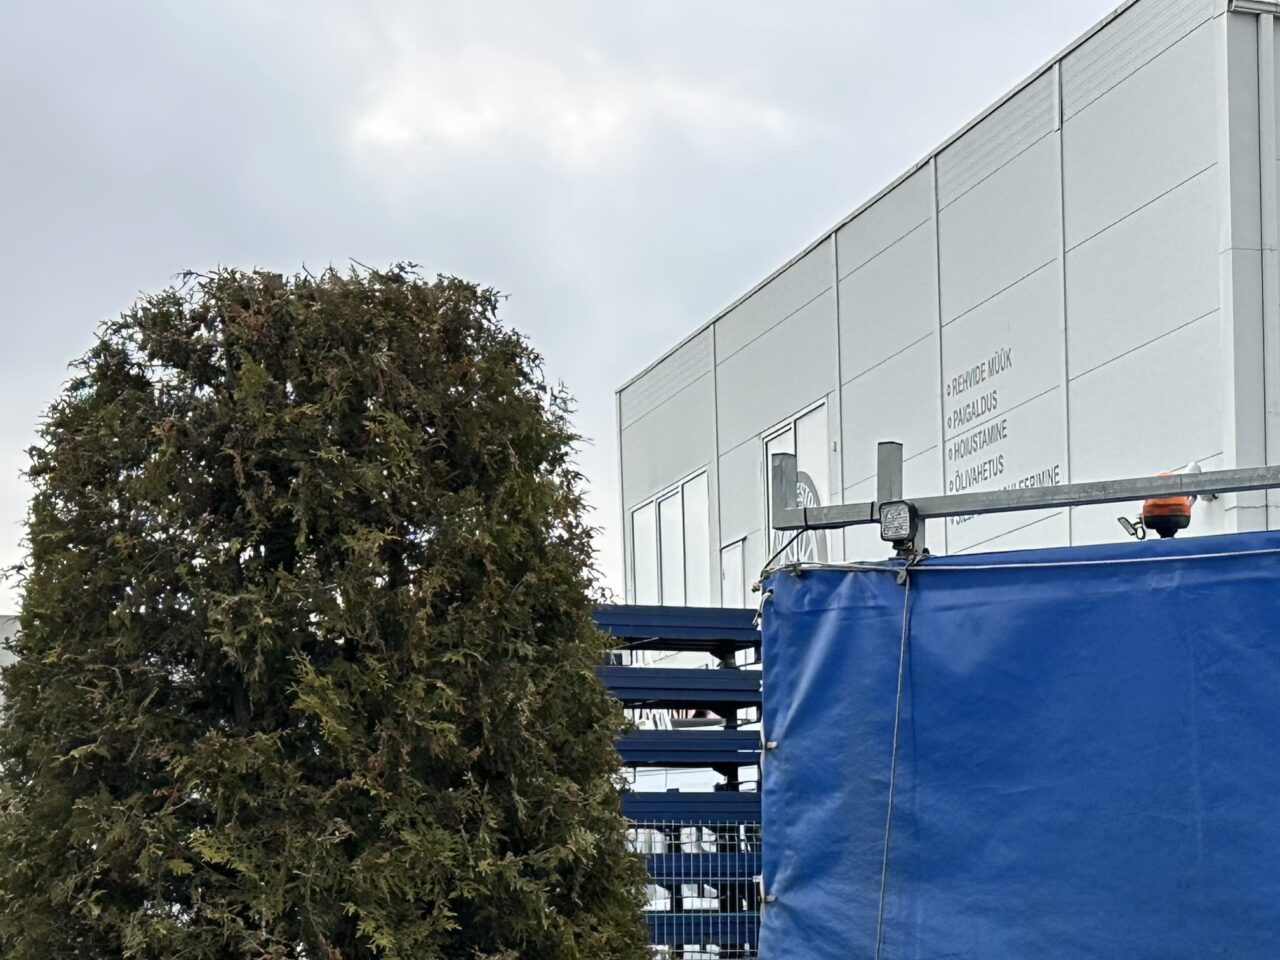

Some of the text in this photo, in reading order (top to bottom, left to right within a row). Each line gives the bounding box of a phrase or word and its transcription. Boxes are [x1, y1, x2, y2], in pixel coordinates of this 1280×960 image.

[951, 348, 1013, 397] REHVIDE MÜÜK
[953, 390, 998, 430] PAIGALDUS
[955, 454, 1004, 493] ÕLIVAHETUS
